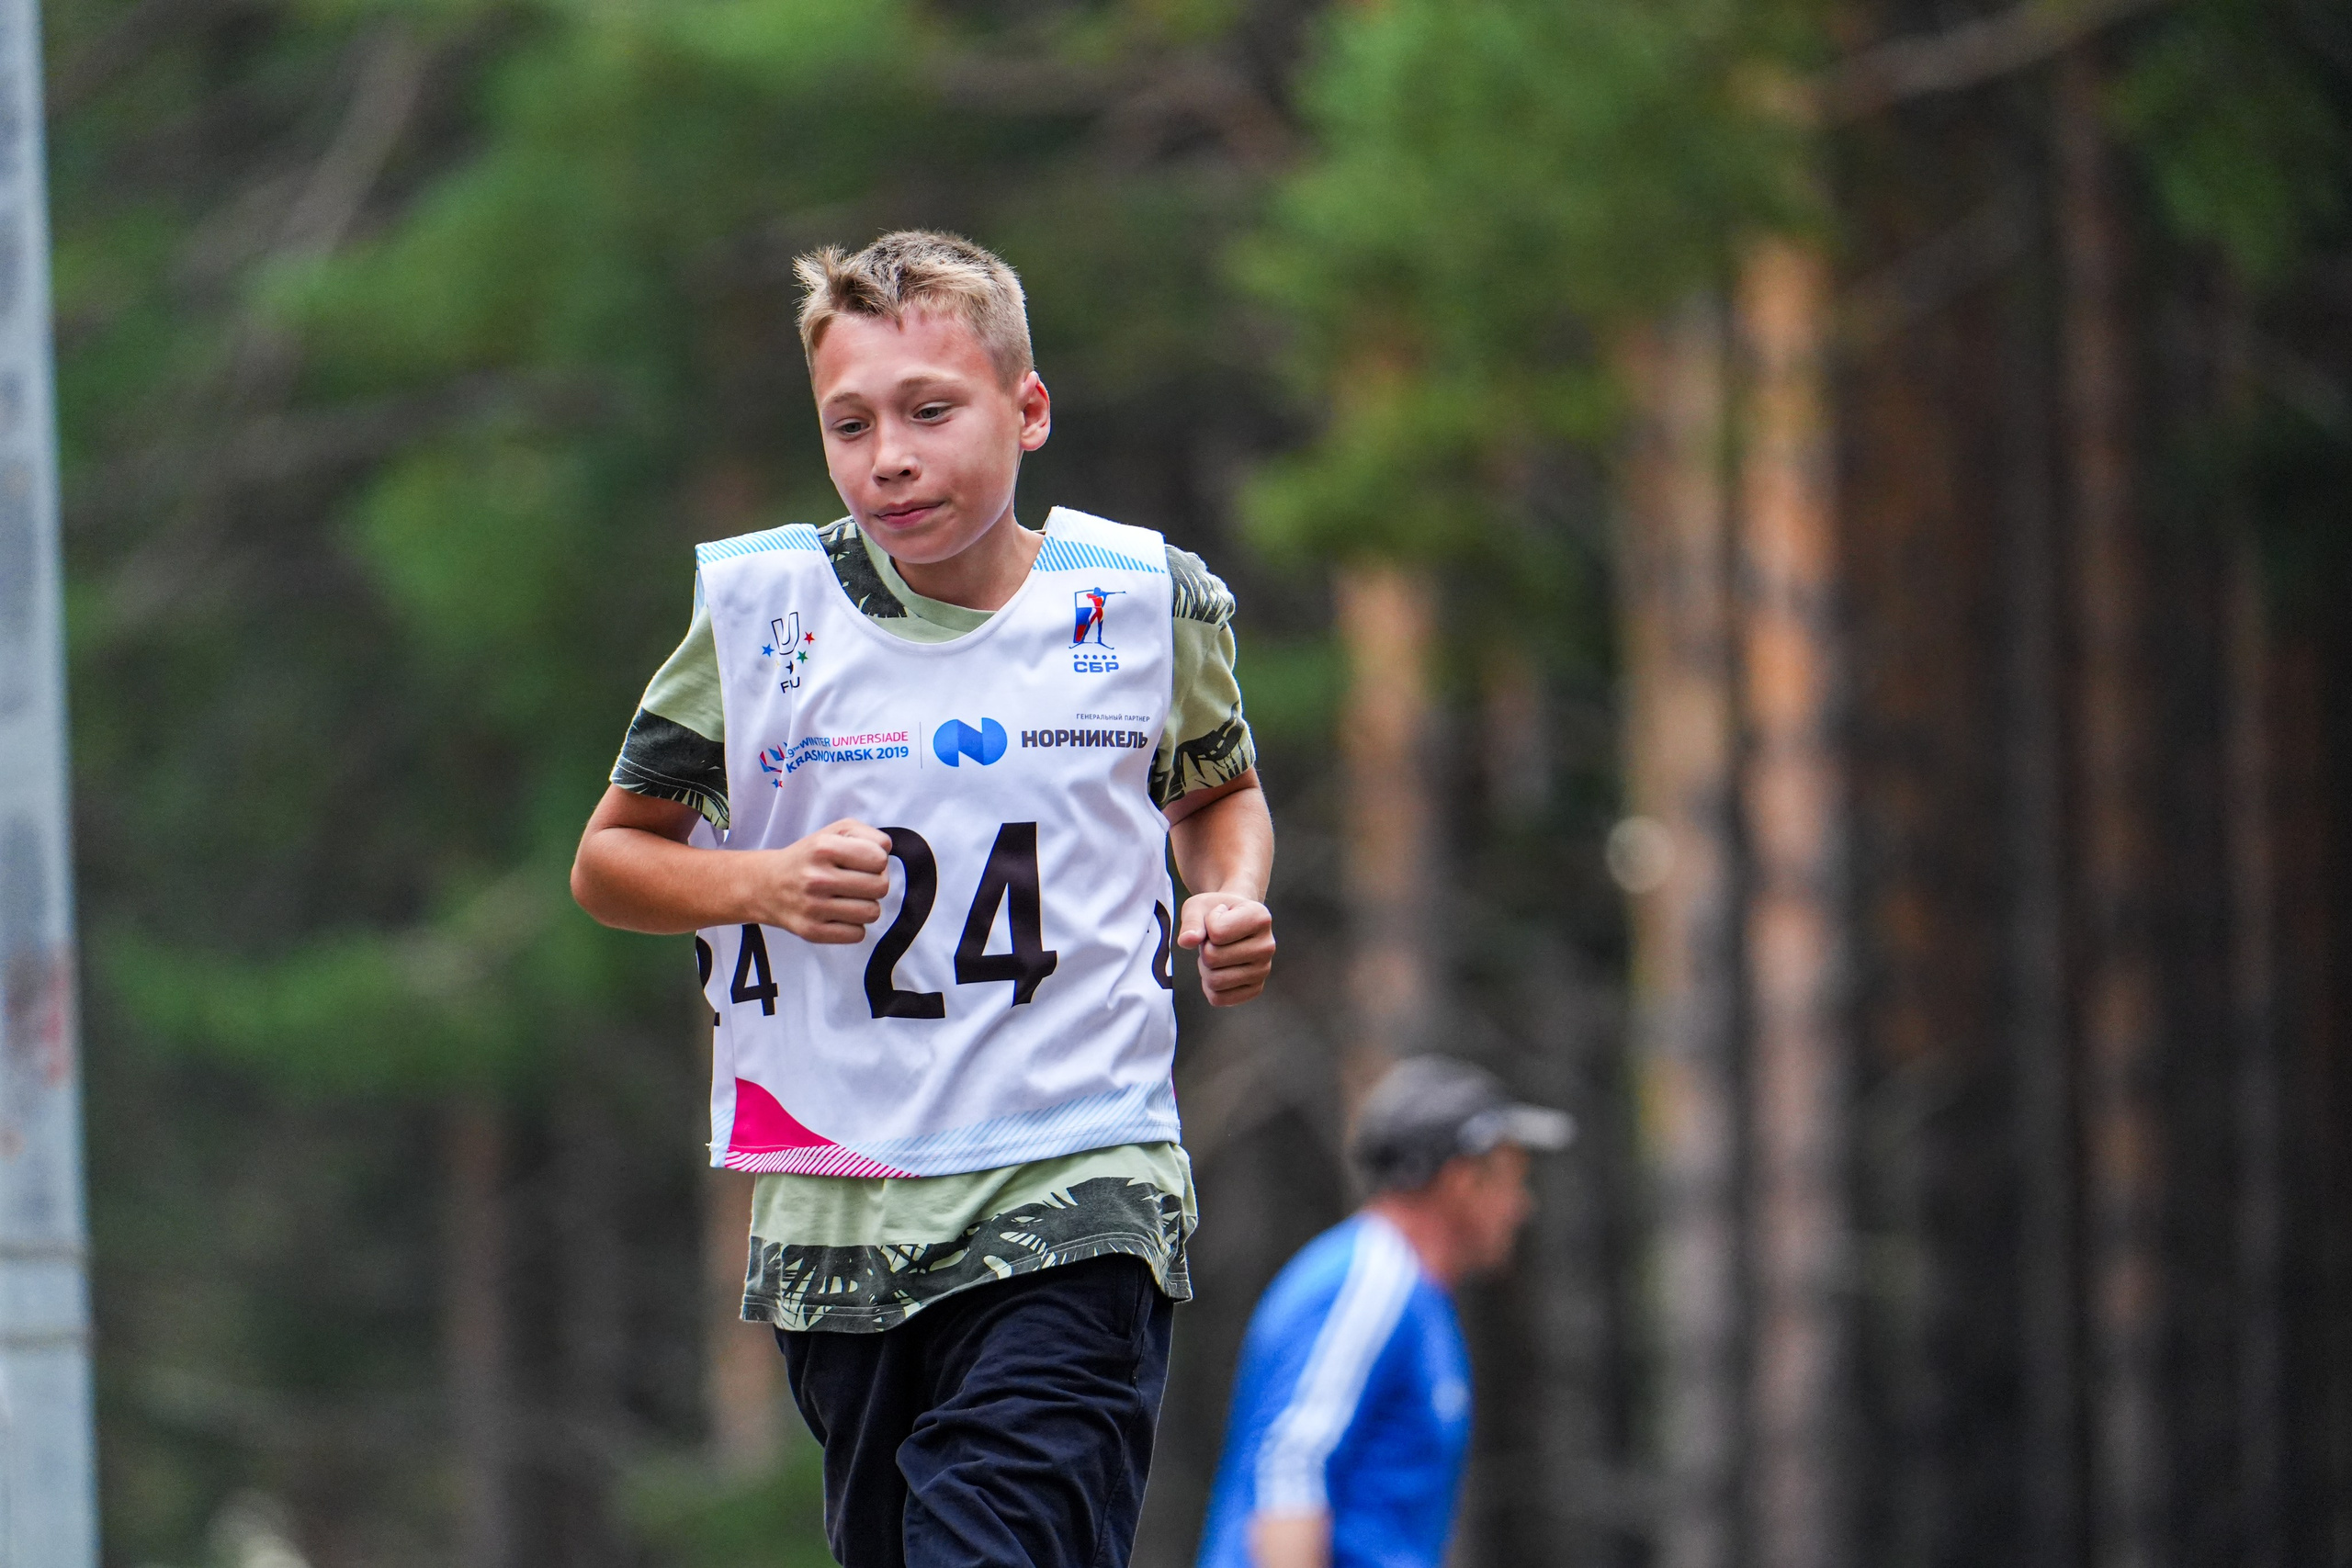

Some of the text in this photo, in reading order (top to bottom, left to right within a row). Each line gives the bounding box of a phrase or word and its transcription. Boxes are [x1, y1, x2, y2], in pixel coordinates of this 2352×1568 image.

[1073, 661, 1119, 673] СБР
[780, 676, 800, 694] FU
[1076, 713, 1123, 721] ГЕНЕРАЛЬНЫЙ
[799, 736, 831, 750] WINTER
[831, 731, 909, 747] UNIVERSIADE
[1021, 729, 1148, 749] НОРНИКЕЛЬ
[786, 746, 909, 773] KRASNOYARSK 2019
[864, 821, 1057, 1020] 24
